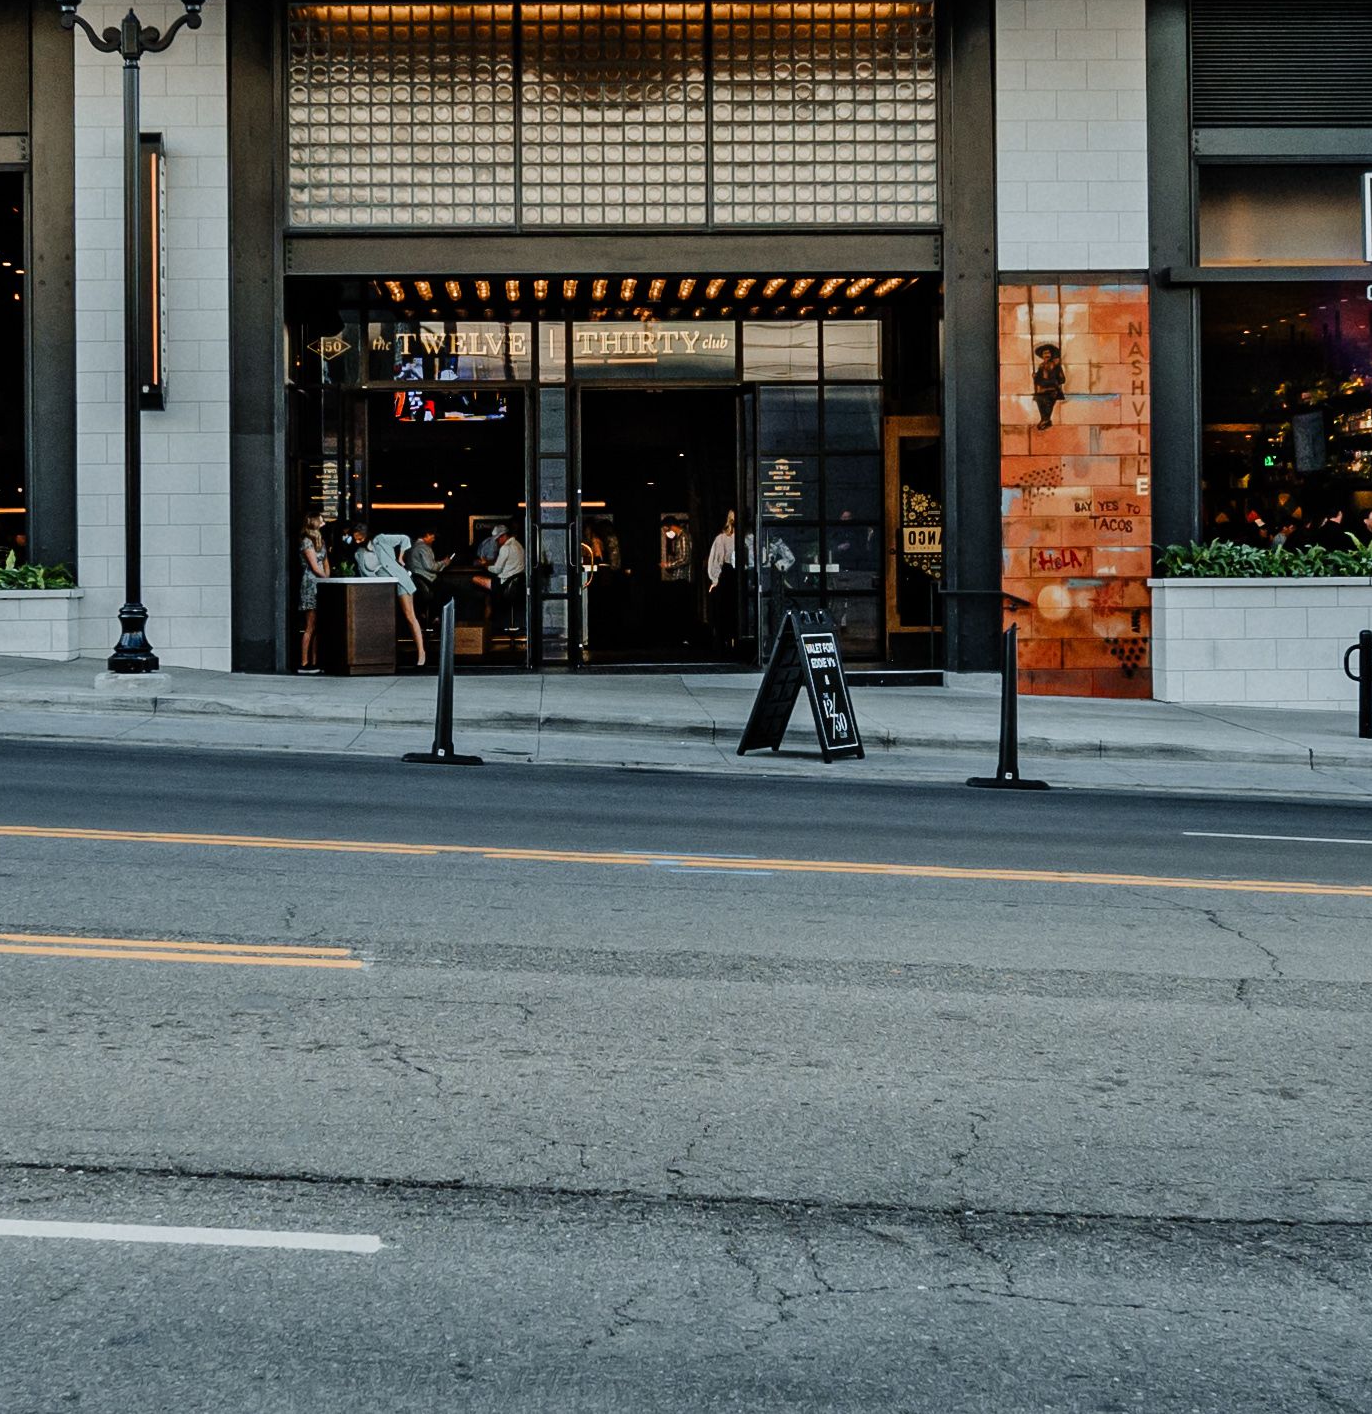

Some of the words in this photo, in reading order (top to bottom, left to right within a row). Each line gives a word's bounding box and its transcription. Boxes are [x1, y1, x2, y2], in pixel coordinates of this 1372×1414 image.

[372, 336, 392, 352] the
[396, 333, 526, 355] TWELVE
[577, 331, 700, 354] THIRTY
[702, 334, 729, 349] club
[1128, 322, 1149, 496] NASHVILLE
[1098, 500, 1119, 512] YES
[1126, 503, 1141, 515] TO
[1089, 516, 1133, 533] TACOS
